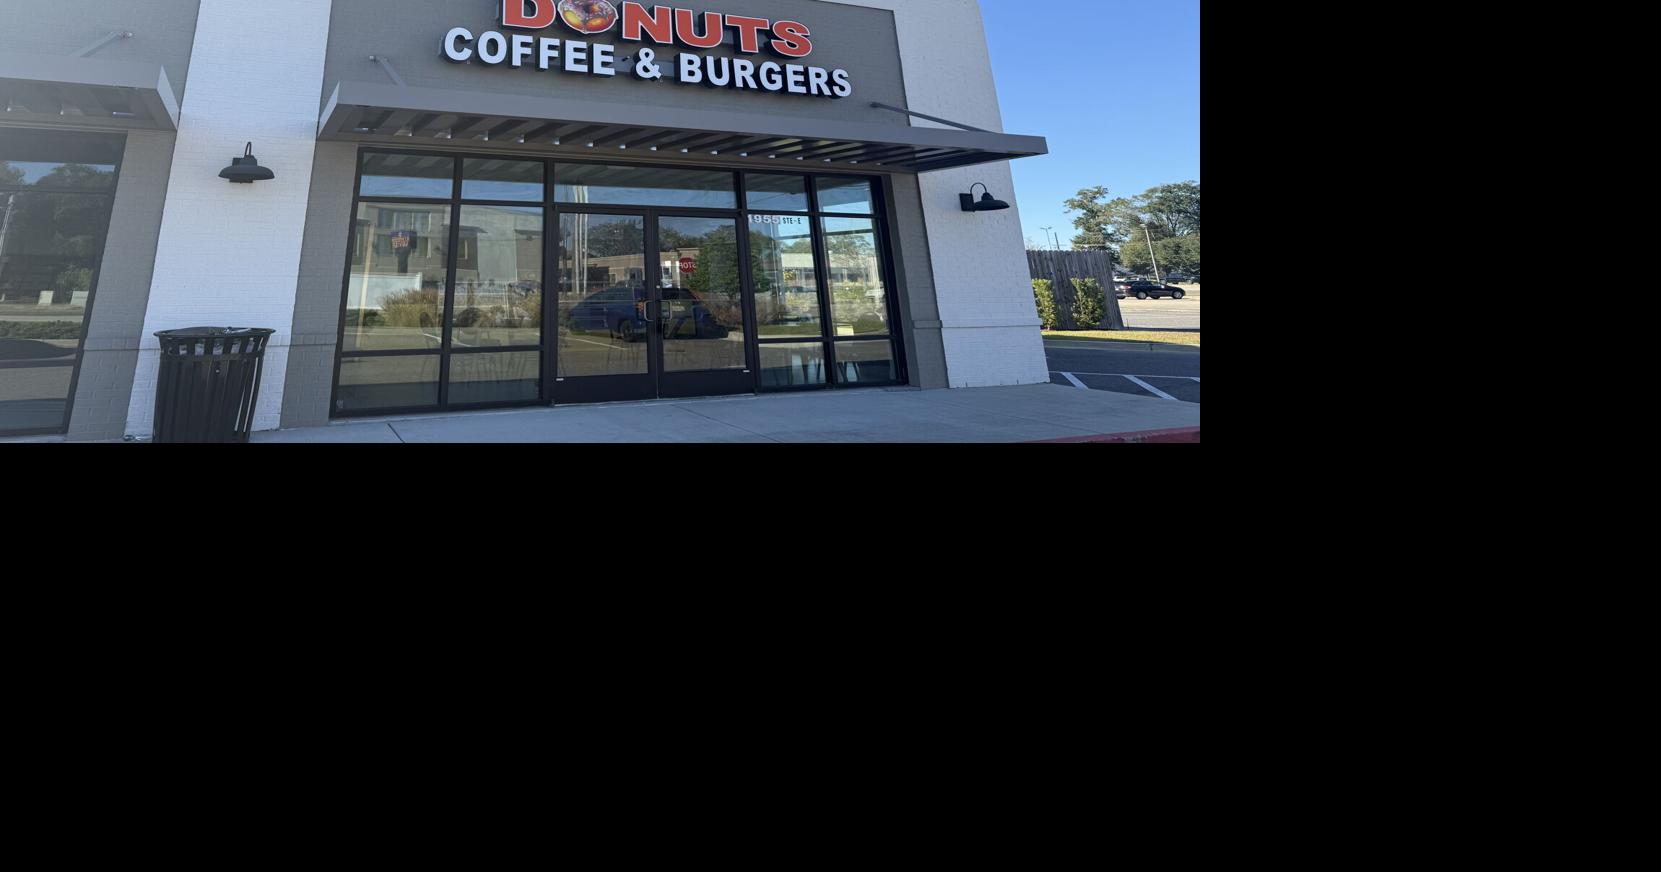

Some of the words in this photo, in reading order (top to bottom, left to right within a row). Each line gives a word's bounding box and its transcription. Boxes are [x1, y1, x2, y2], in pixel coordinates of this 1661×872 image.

[444, 27, 615, 76] COFFEE
[635, 47, 662, 80] &
[679, 52, 852, 97] BURGERS
[747, 213, 780, 224] 1955
